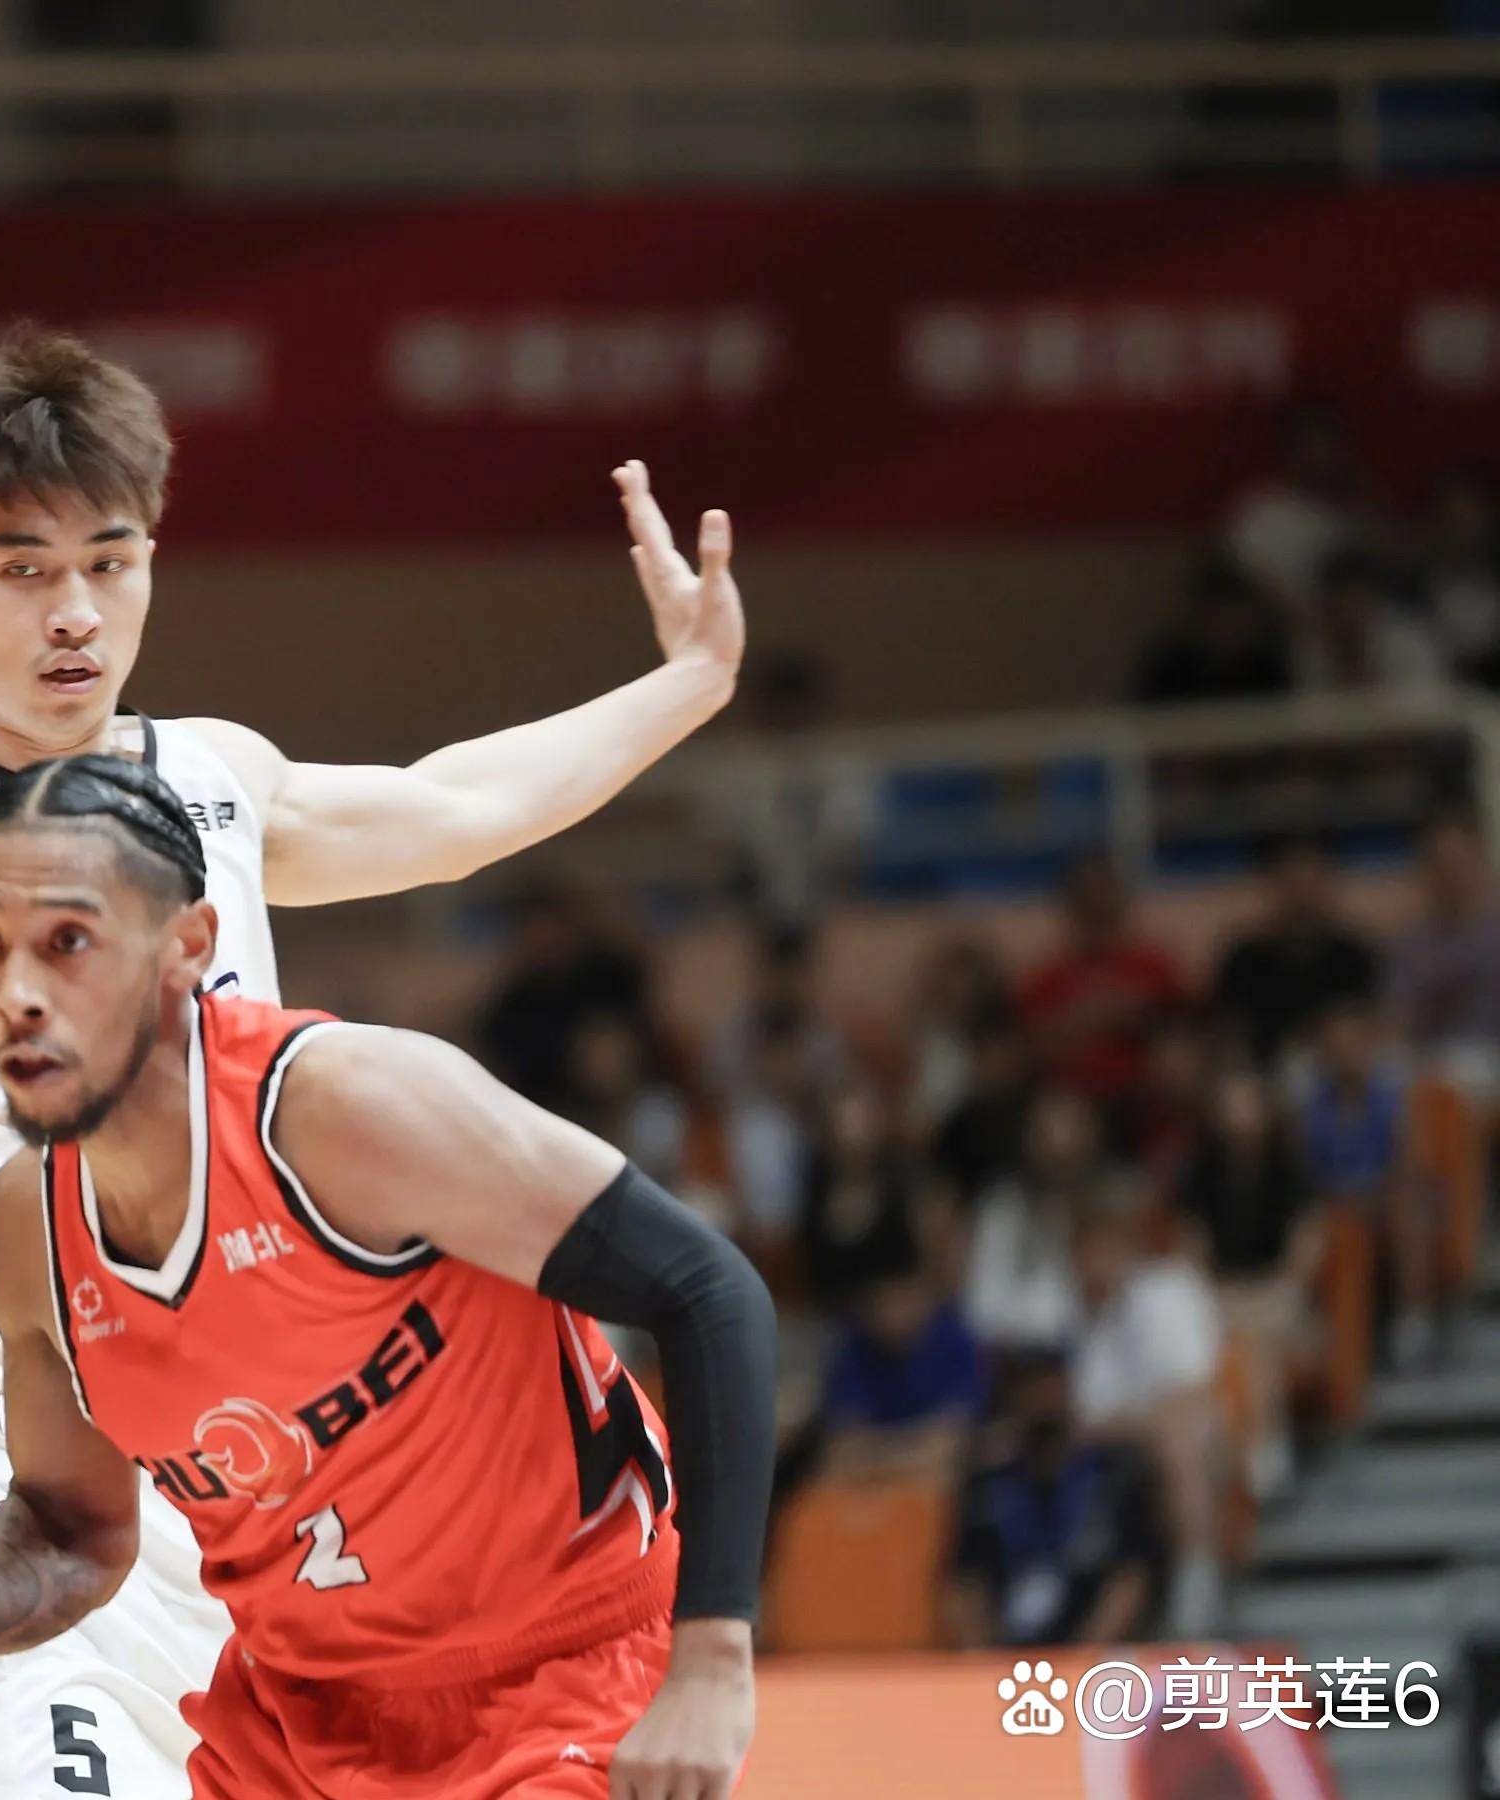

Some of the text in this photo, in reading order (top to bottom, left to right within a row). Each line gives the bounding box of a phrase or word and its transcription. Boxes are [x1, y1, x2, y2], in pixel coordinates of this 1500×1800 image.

[293, 1298, 446, 1450] BEI
[293, 1503, 370, 1591] 2
[50, 1703, 111, 1797] 5
